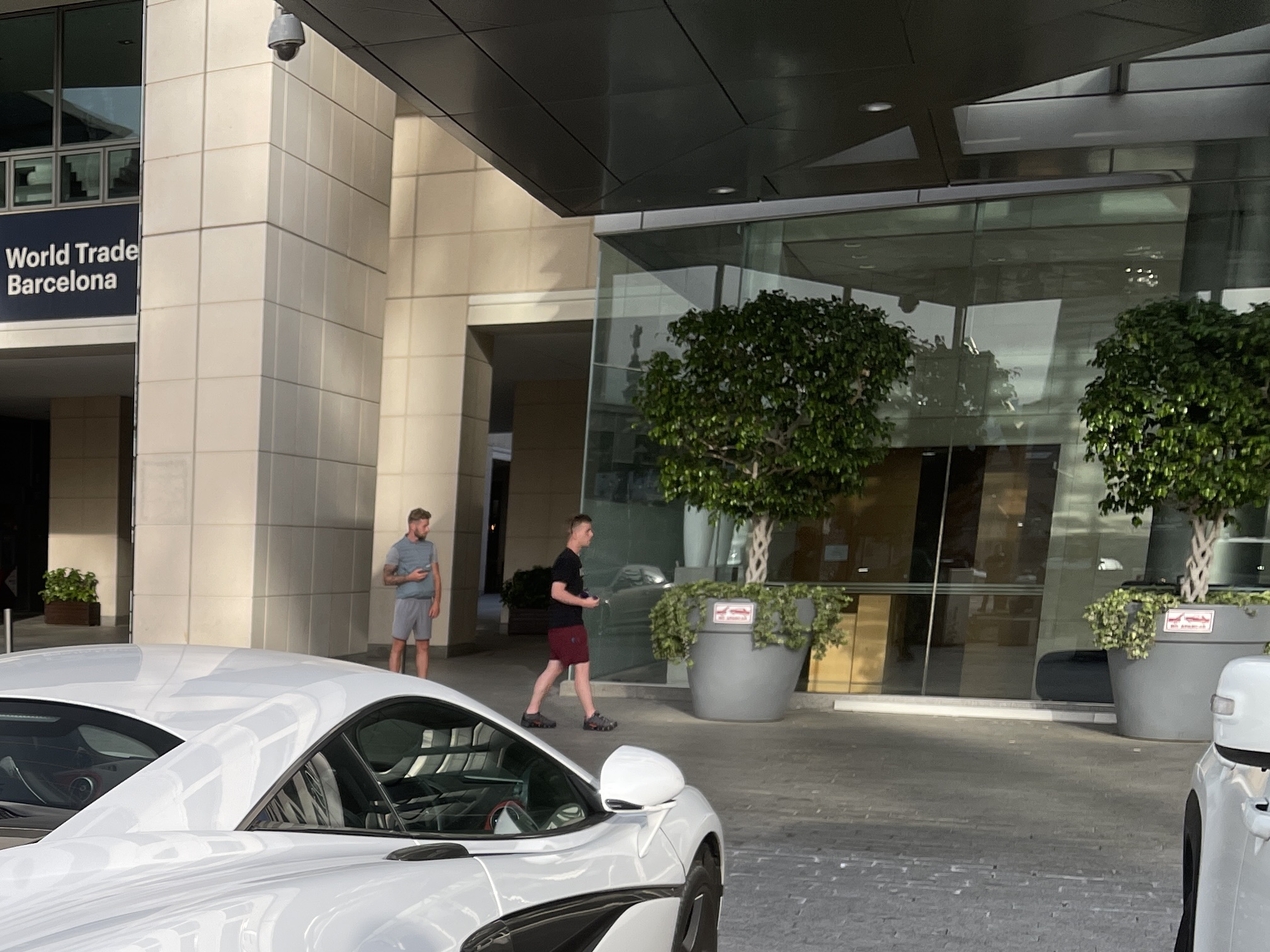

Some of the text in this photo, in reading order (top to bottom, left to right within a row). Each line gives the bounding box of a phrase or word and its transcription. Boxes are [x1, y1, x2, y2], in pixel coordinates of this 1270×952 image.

[5, 238, 139, 269] World Trade
[7, 270, 118, 296] Barcelona
